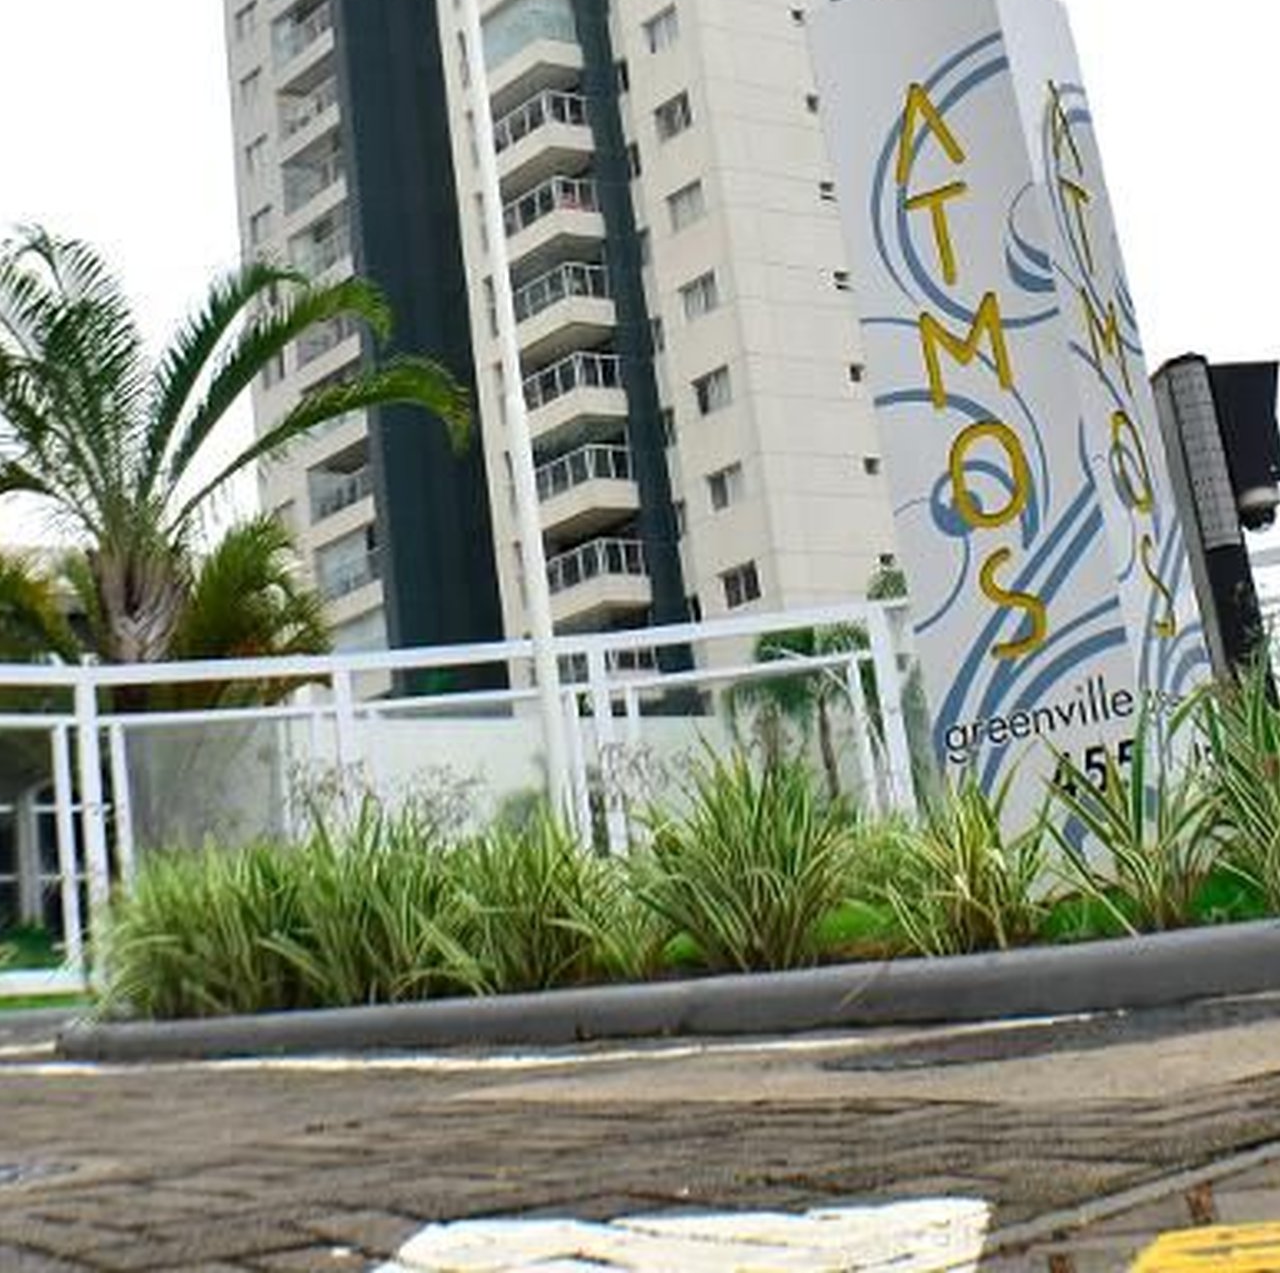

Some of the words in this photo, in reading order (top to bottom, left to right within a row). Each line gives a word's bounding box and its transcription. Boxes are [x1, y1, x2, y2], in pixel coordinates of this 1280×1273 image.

[895, 82, 1050, 659] ATMOS
[1047, 78, 1176, 638] ATMOS
[944, 675, 1135, 764] greenville
